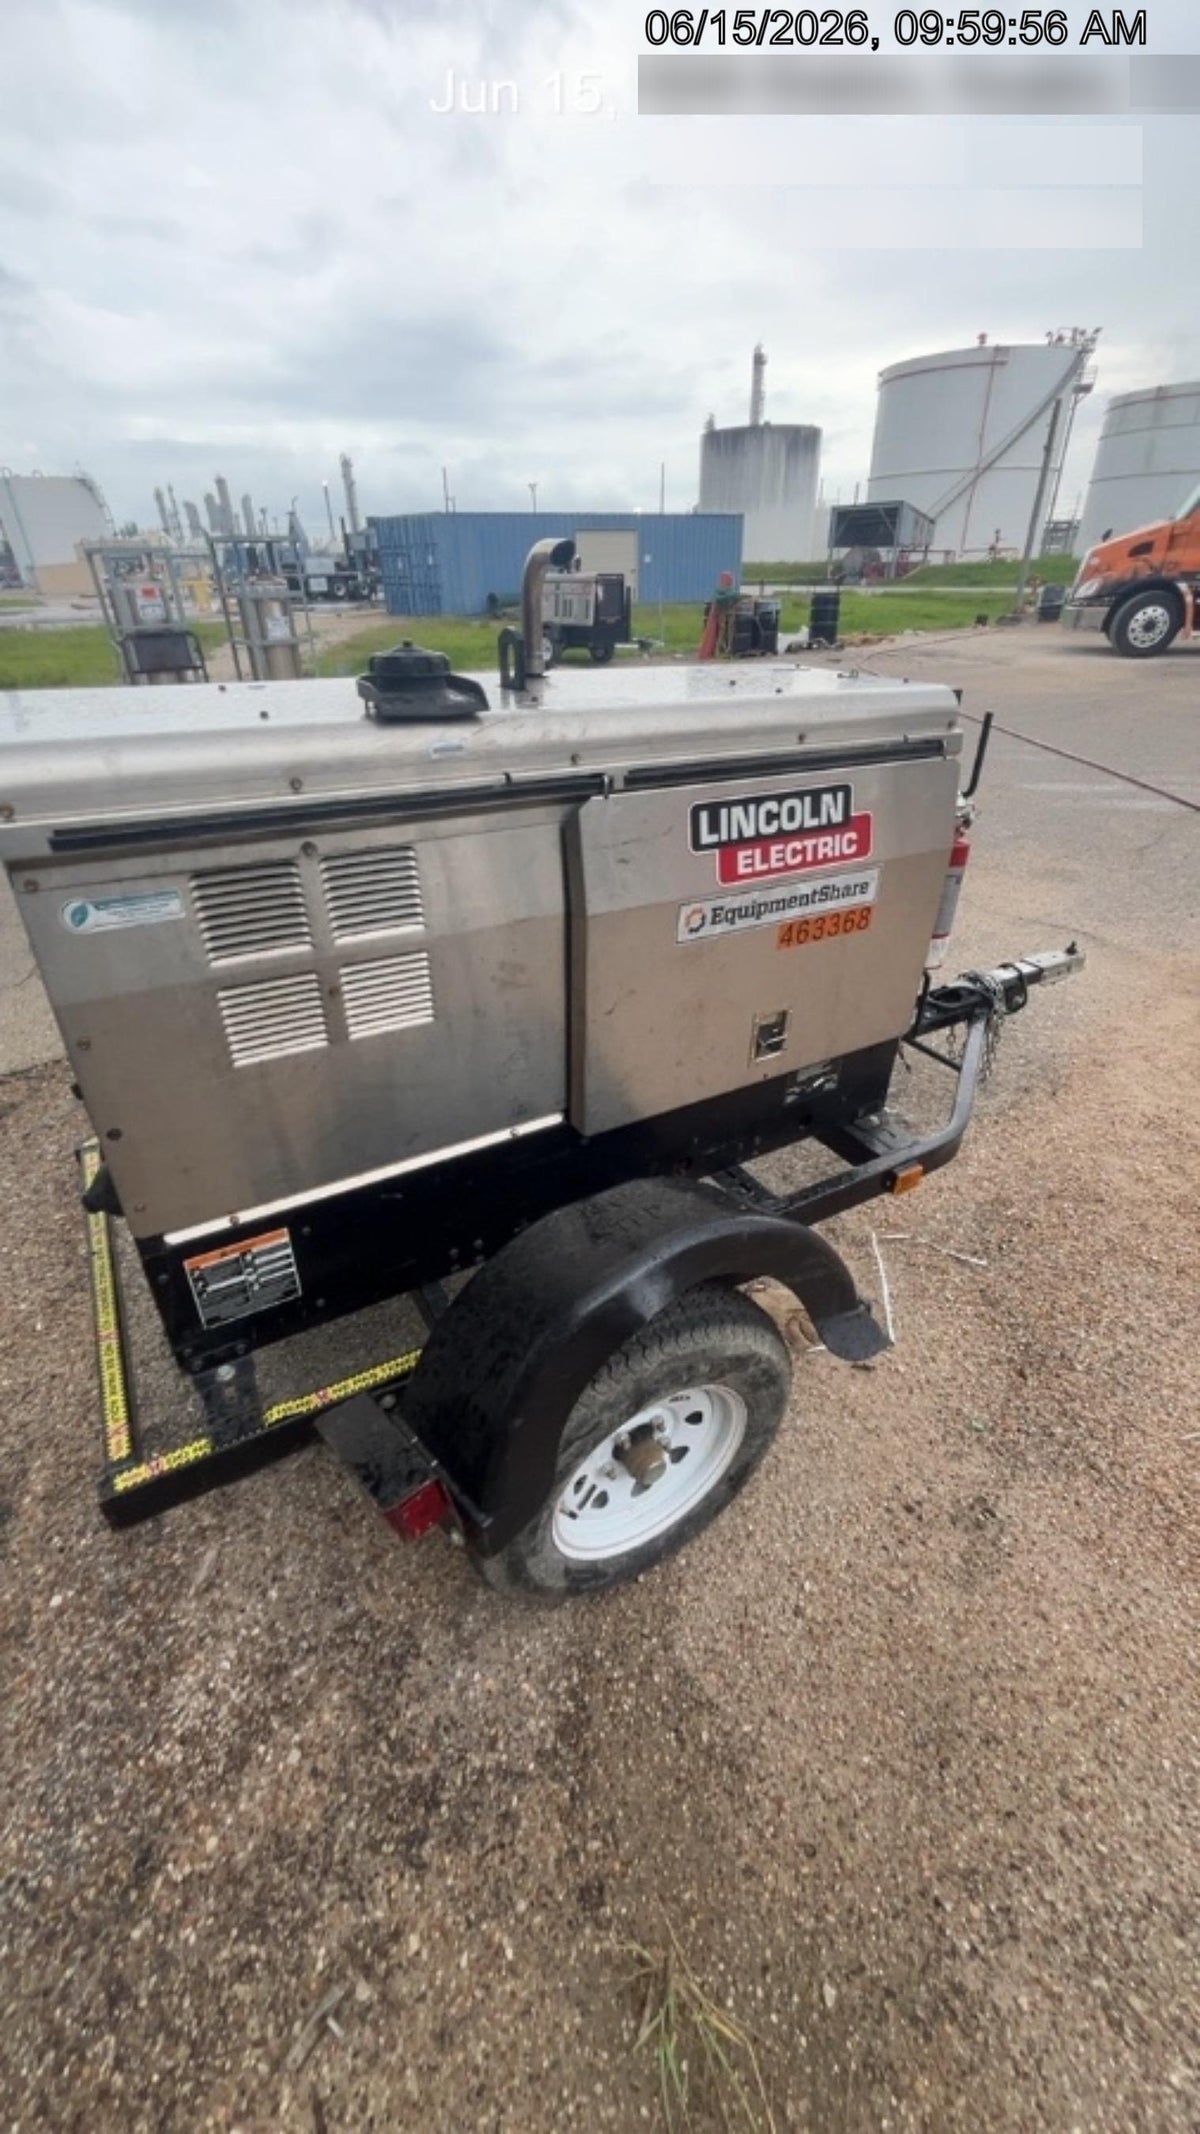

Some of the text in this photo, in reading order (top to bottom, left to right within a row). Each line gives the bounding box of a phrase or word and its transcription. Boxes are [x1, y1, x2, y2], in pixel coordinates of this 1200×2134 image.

[699, 791, 845, 845] LINCOLN
[736, 831, 858, 876] ELECTRIC
[710, 881, 870, 926] EquipmentShare
[778, 906, 872, 947] 463368
